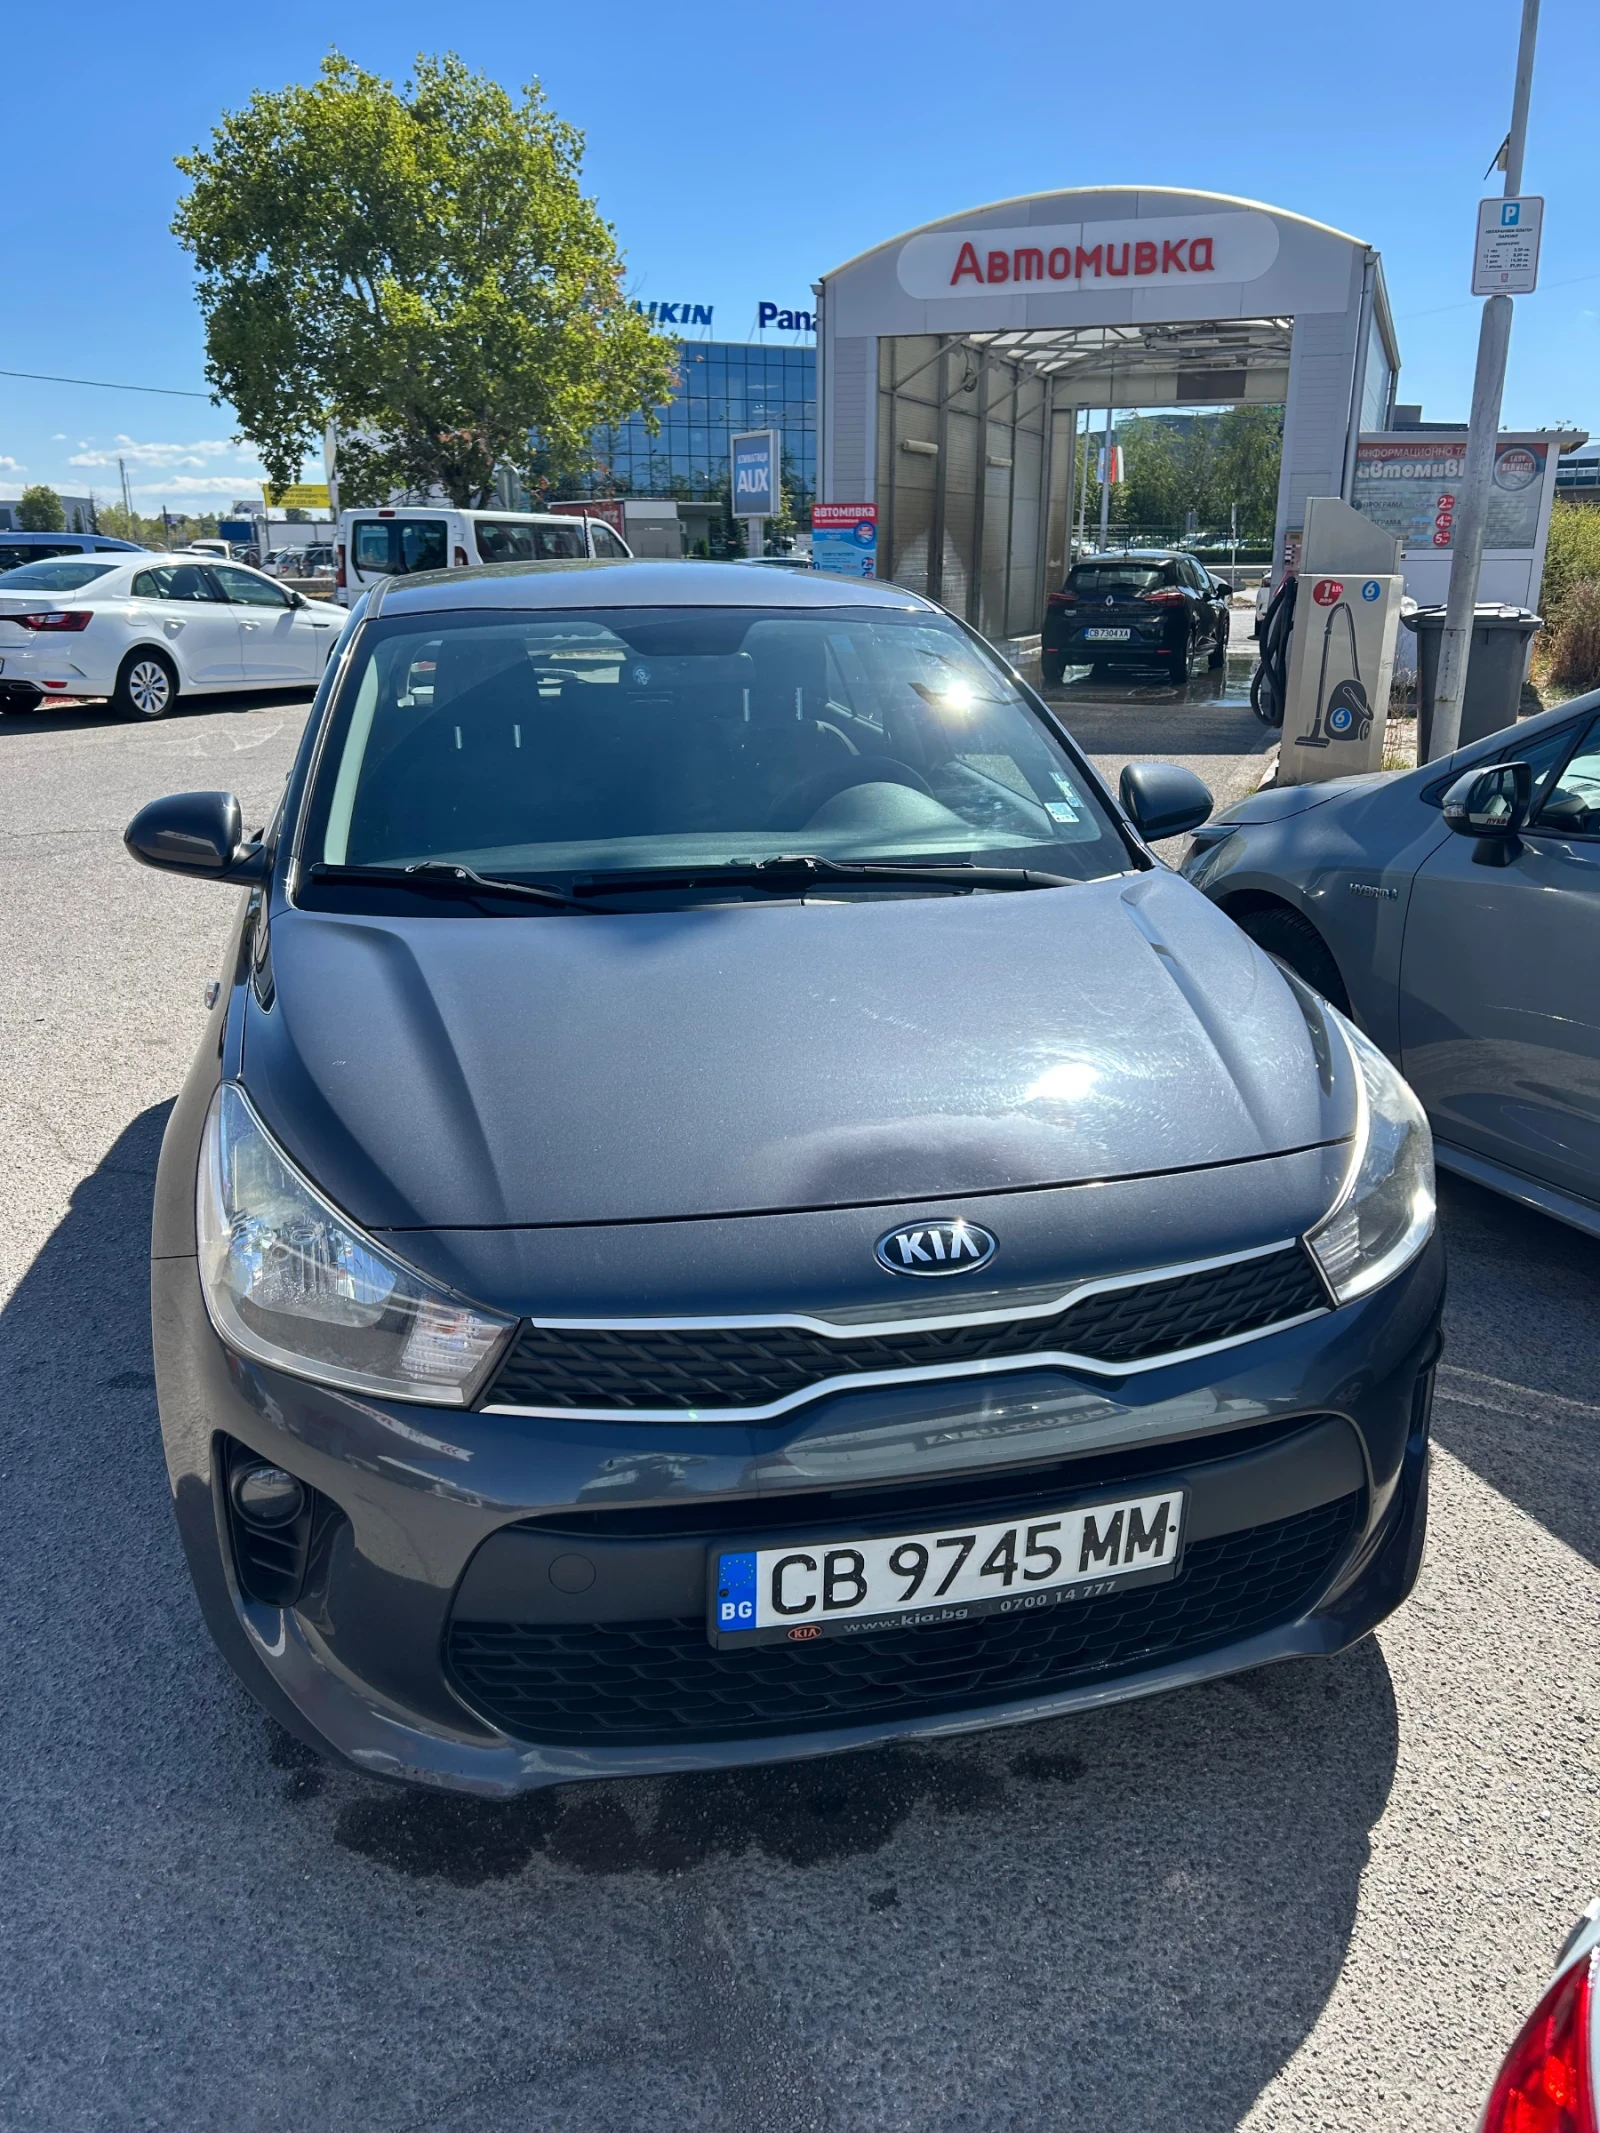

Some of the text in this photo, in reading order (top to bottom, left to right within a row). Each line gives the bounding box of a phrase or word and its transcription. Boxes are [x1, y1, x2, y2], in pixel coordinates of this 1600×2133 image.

[1504, 206, 1517, 223] P
[950, 237, 1215, 285] Автомивка
[1358, 446, 1468, 458] ИНФОРМАЦИОННО ТА
[1356, 458, 1465, 478] автомив
[1502, 462, 1532, 471] SERVICE
[737, 467, 768, 493] AUX
[814, 507, 875, 517] автомивка
[1437, 516, 1445, 526] 4
[1435, 534, 1443, 544] 5
[1324, 583, 1331, 597] 1
[1365, 583, 1375, 596] 6
[1336, 713, 1345, 724] 6
[1350, 883, 1389, 899] HYBRID
[896, 1229, 980, 1264] KIA
[771, 1502, 1171, 1616] CB 9745 MM
[721, 1602, 752, 1621] BG
[844, 1581, 1117, 1633] www.kia.bg 0700 14 777
[792, 1628, 819, 1639] KIA
